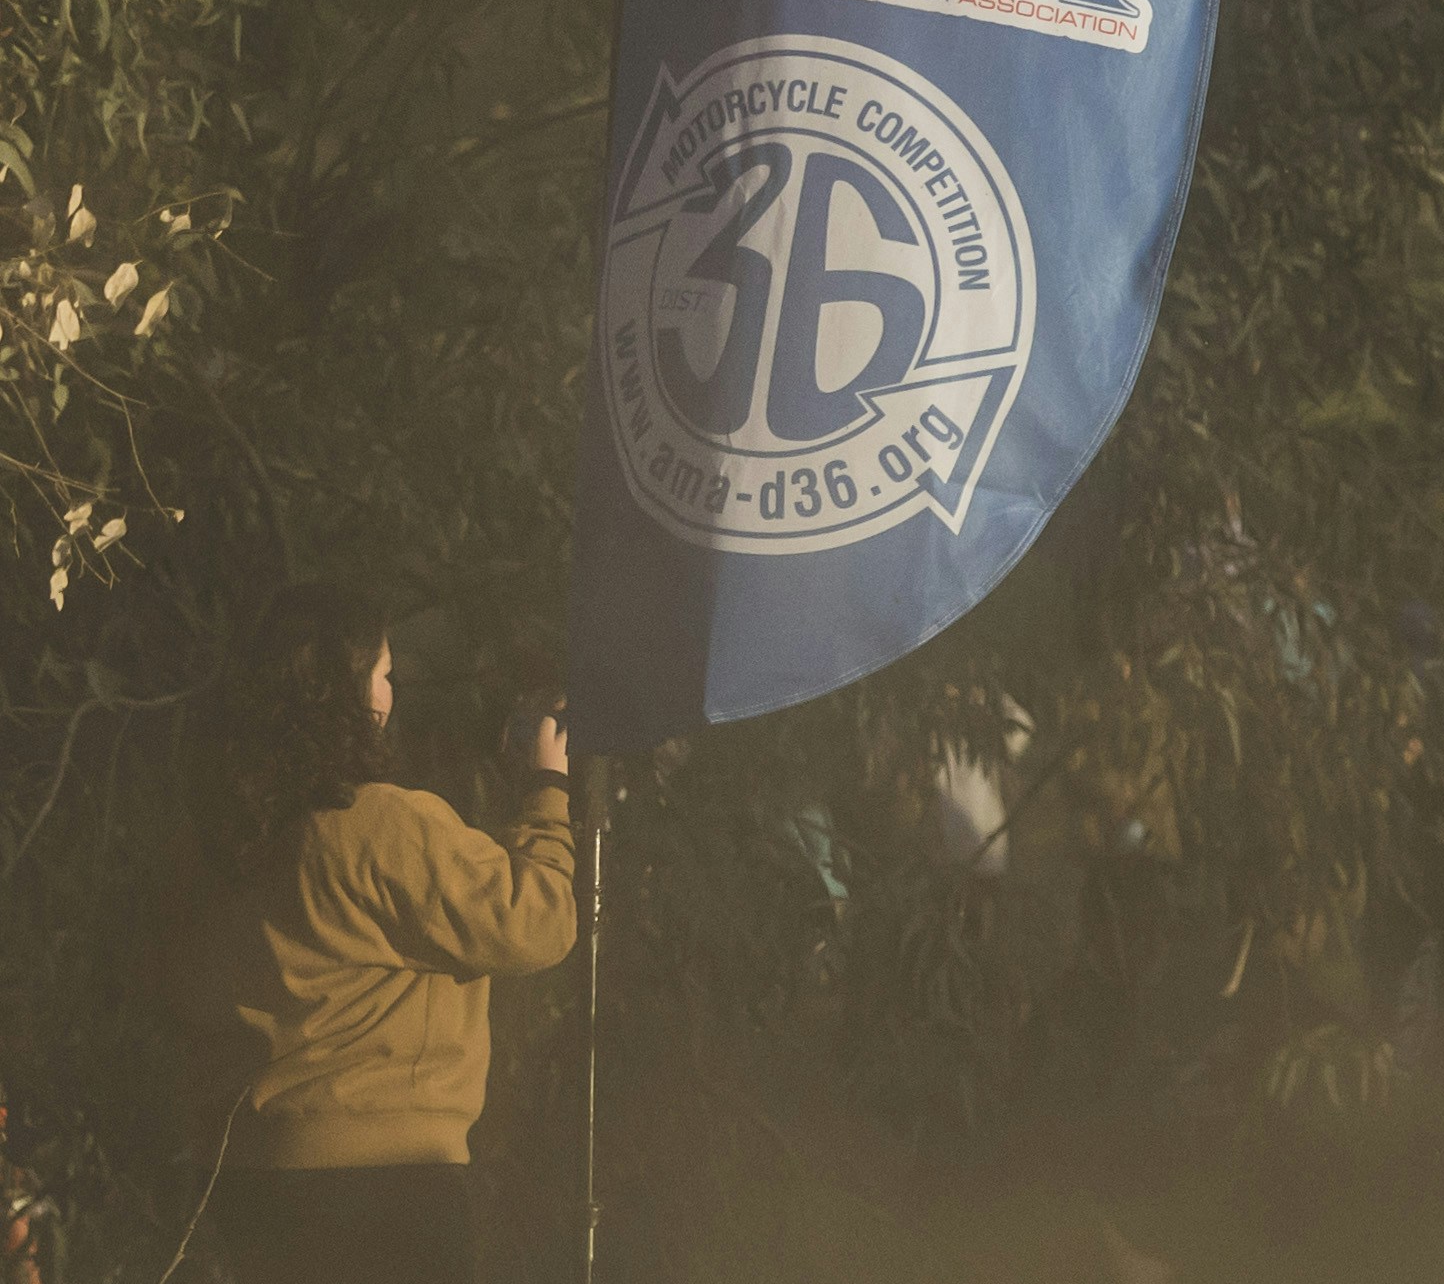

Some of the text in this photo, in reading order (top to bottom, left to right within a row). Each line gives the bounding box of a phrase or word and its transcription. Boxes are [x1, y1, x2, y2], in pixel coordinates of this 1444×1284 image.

[657, 141, 928, 442] 36
[661, 79, 991, 292] MOTORCYCLE COMPETITION
[614, 319, 965, 520] www.ama-d36.org
